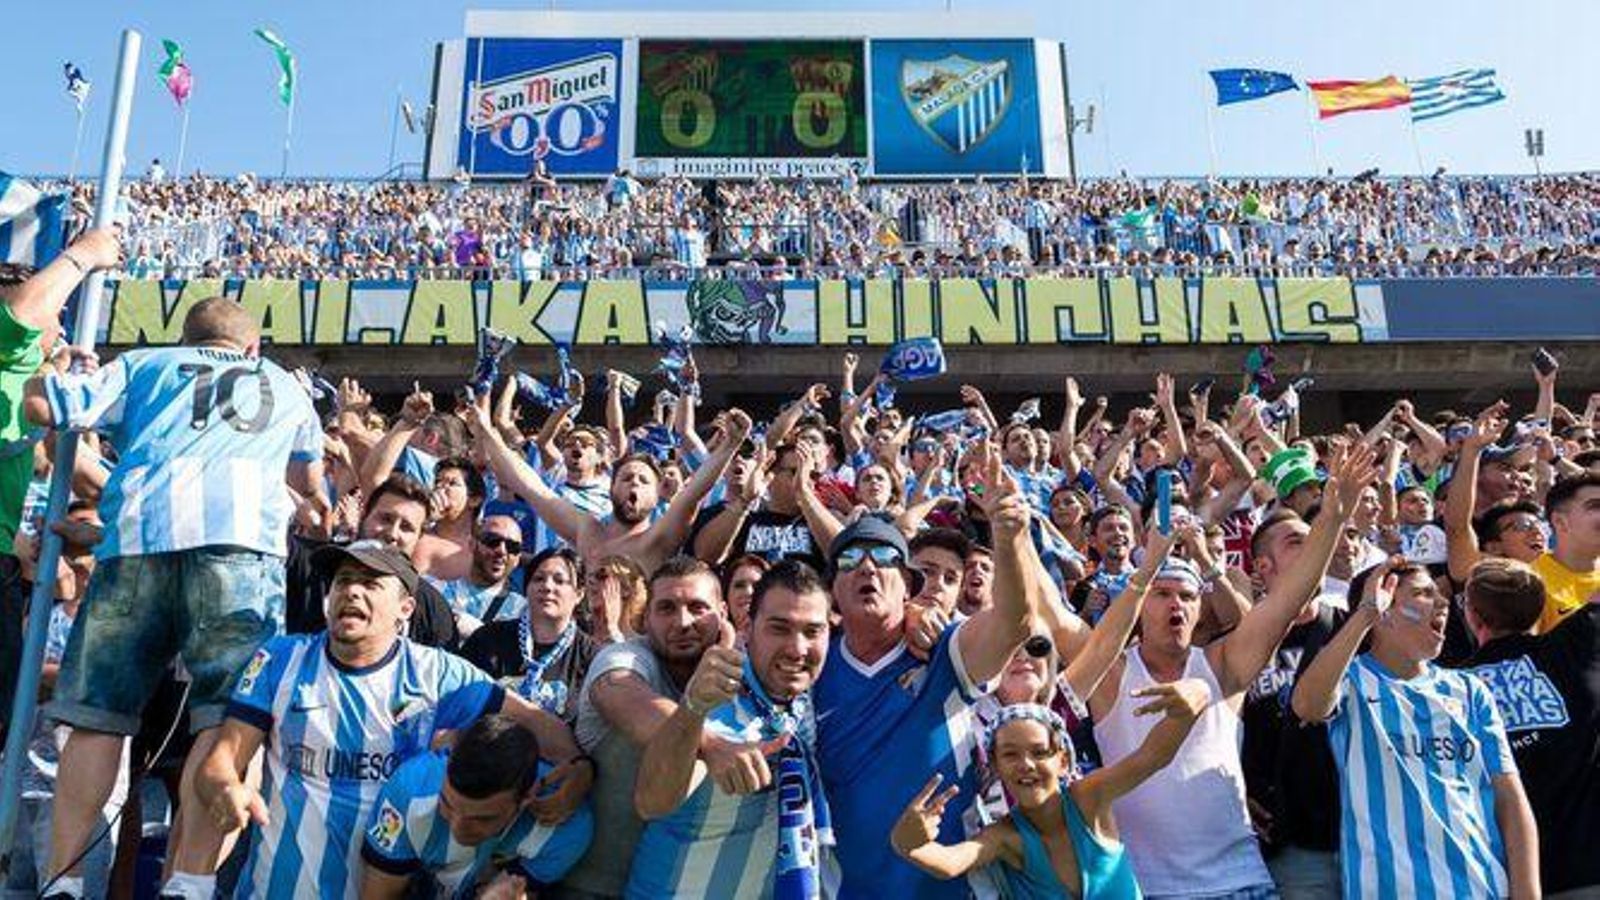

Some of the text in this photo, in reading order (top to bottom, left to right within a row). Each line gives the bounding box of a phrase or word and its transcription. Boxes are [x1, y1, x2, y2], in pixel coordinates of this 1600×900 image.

[480, 66, 607, 120] San Miguel
[661, 88, 847, 148] 0 0
[674, 156, 781, 177] imagining
[106, 278, 1363, 345] MALAKA HINCHAS
[181, 364, 275, 433] 10
[1492, 678, 1555, 702] AKA
[325, 746, 402, 780] UNESC
